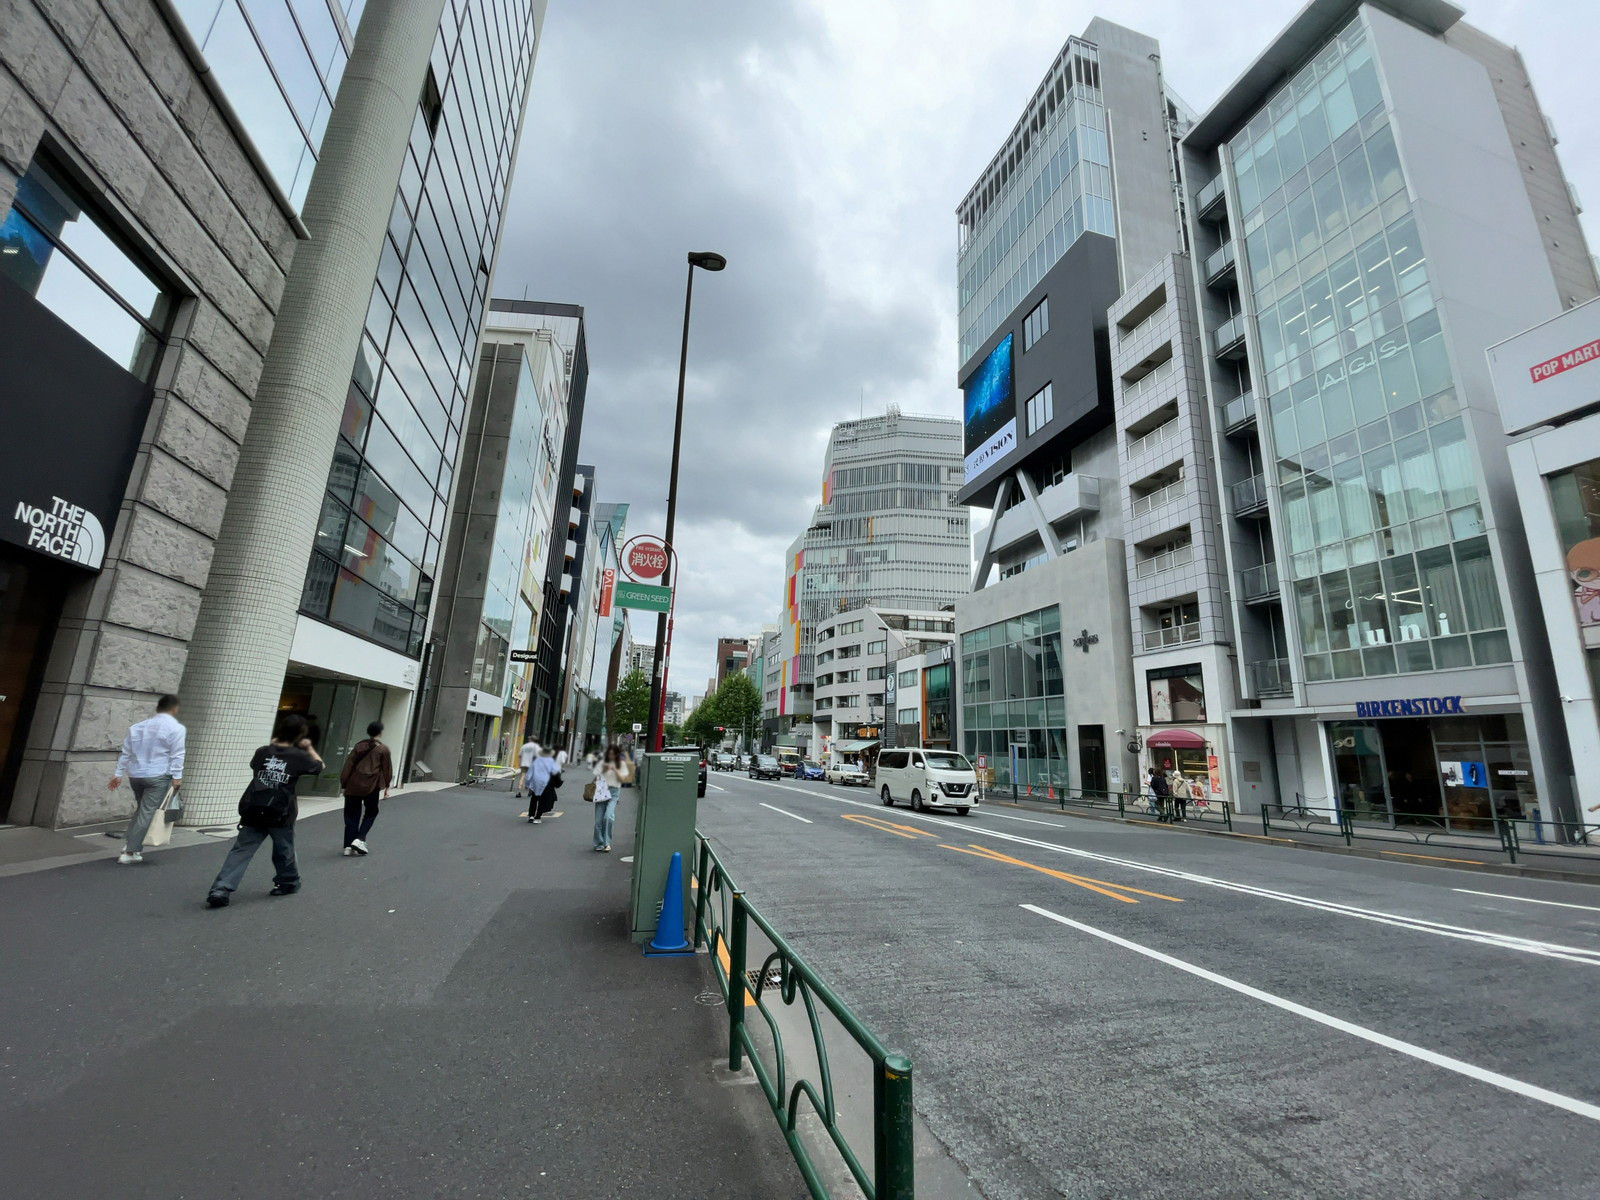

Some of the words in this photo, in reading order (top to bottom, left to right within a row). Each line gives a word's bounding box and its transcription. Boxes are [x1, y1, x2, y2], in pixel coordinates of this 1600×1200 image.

[1533, 360, 1559, 380] POP
[1561, 342, 1599, 368] MART
[14, 501, 80, 542] NORTH
[52, 496, 85, 525] THE
[27, 527, 75, 559] FACE
[631, 551, 664, 569] 消火栓
[625, 592, 650, 601] GREEN
[650, 594, 669, 603] SEED
[942, 646, 951, 660] M
[1356, 696, 1465, 717] BIRKENSTOCK
